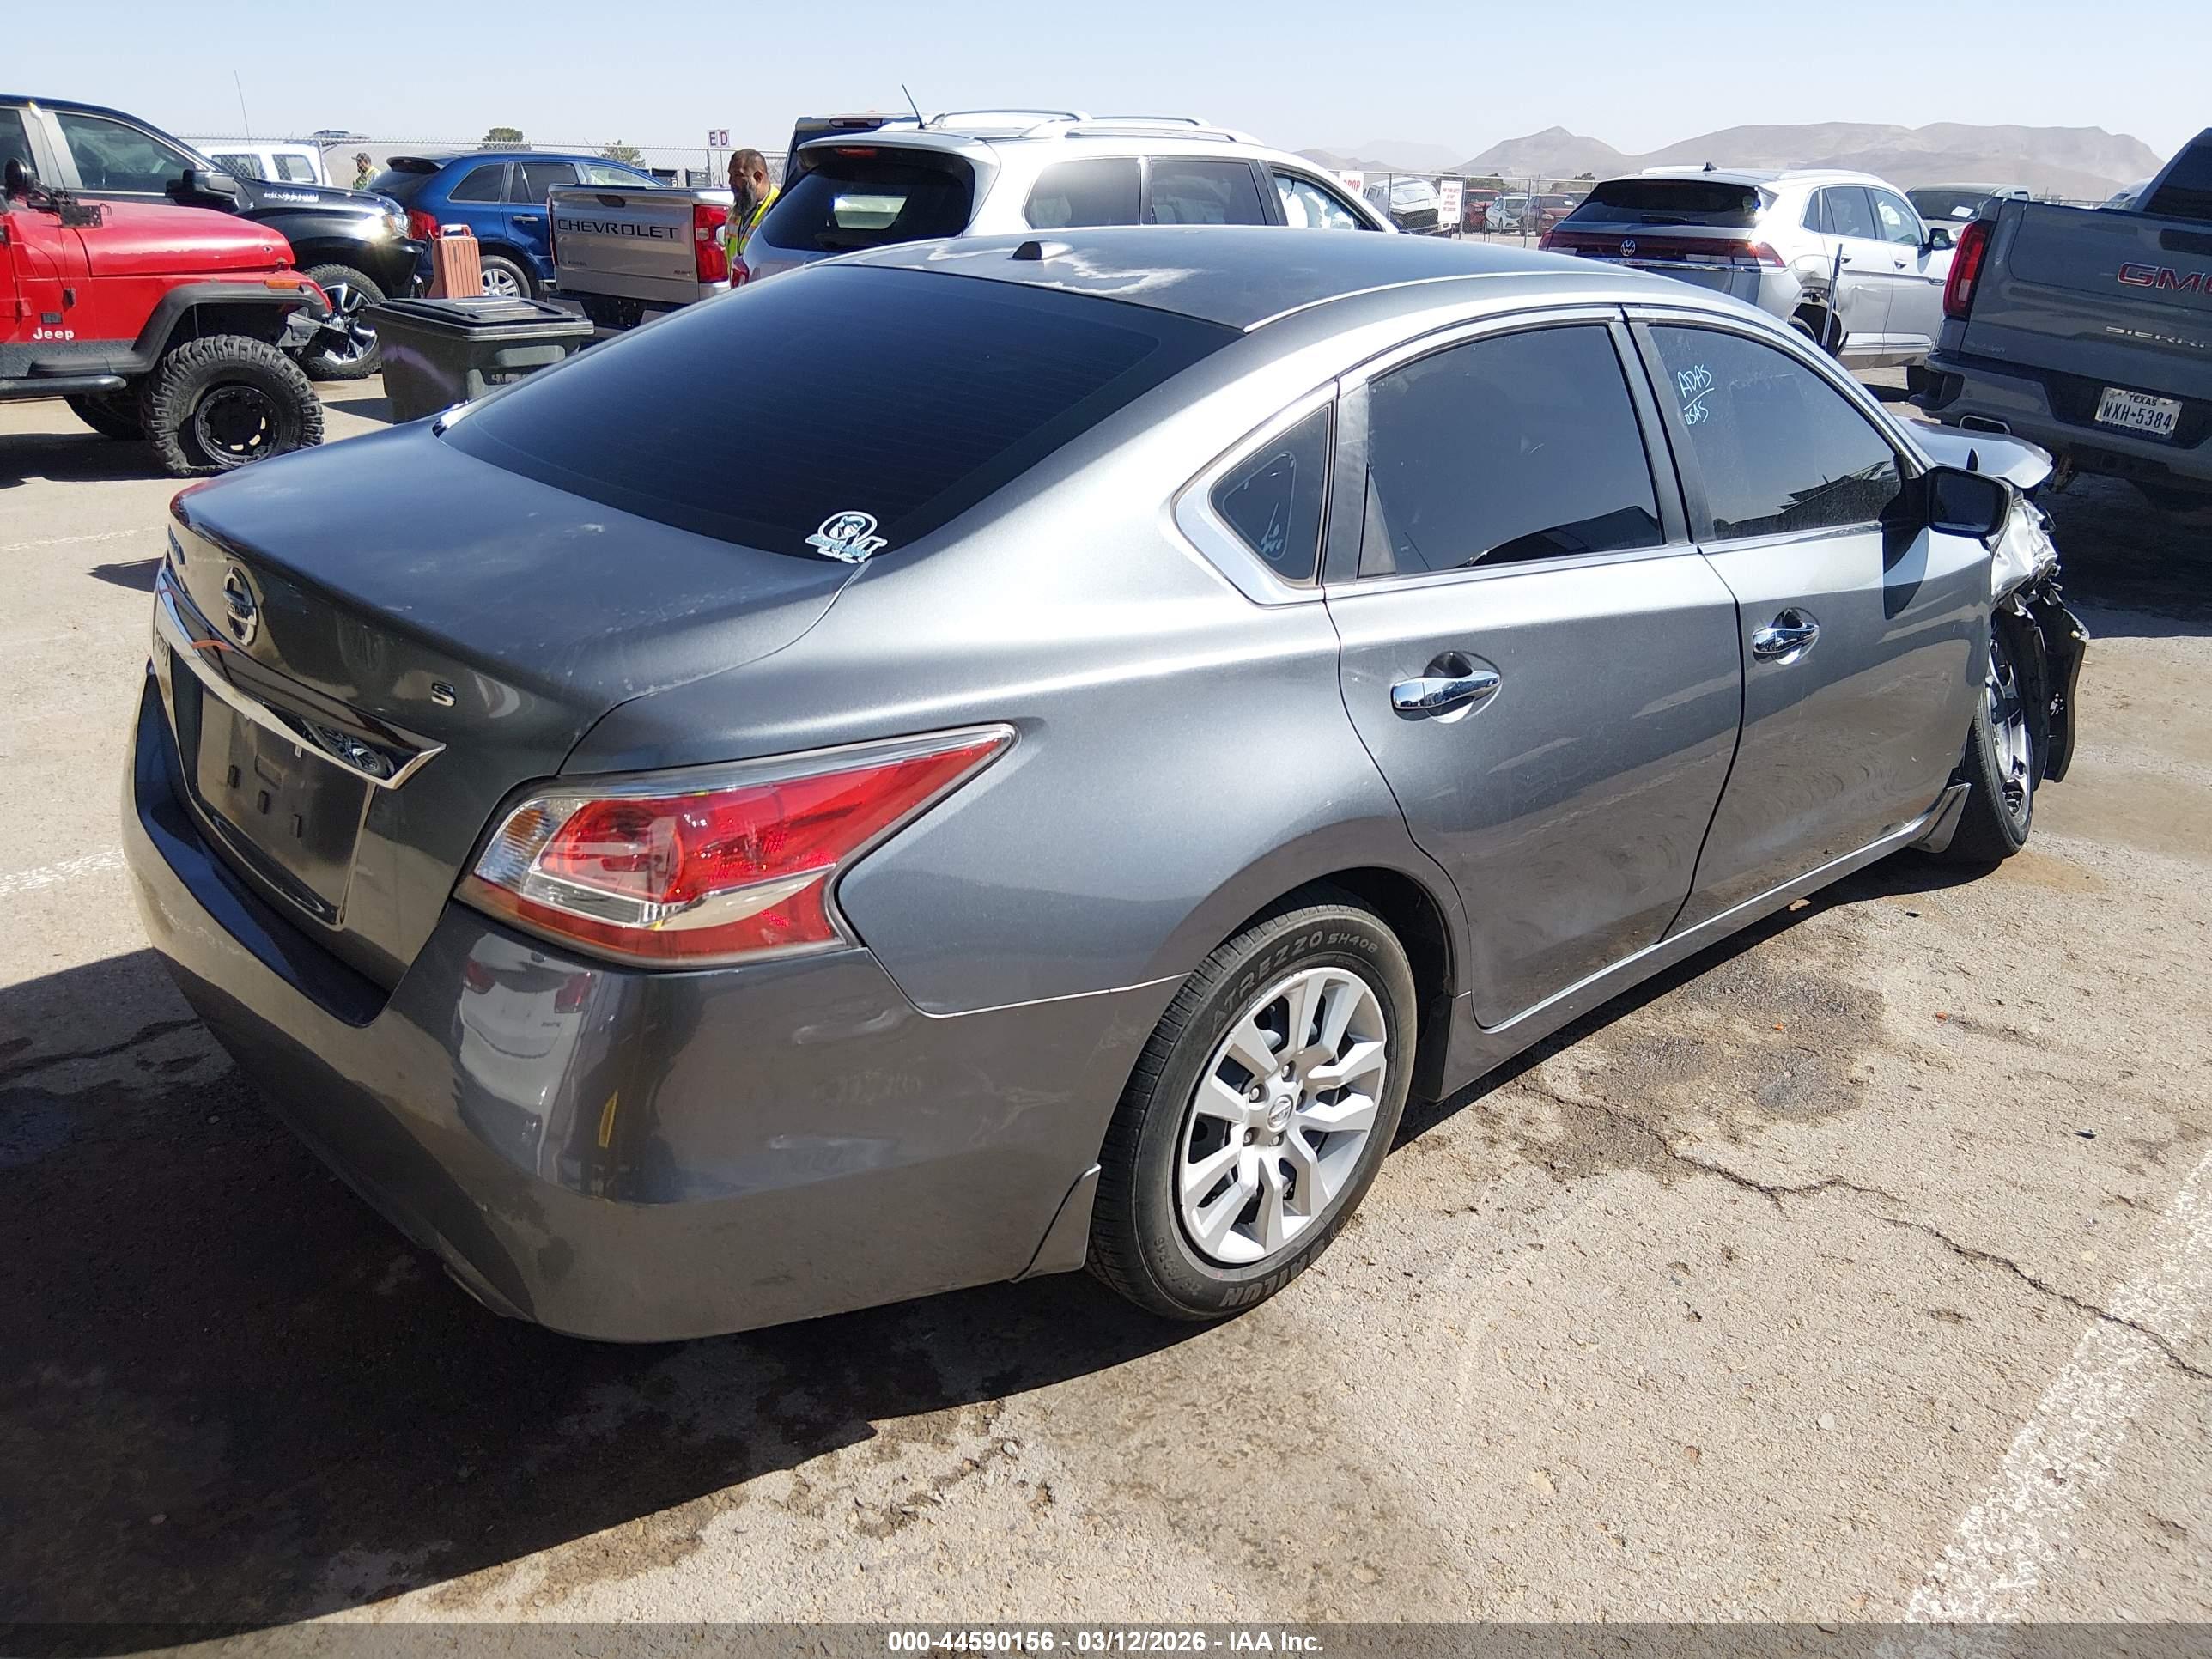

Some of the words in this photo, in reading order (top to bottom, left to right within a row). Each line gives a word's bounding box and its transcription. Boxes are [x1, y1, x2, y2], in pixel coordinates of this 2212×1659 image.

[558, 219, 678, 239] CHEVROLET
[2118, 262, 2212, 294] GM
[33, 327, 75, 341] Jeep
[1677, 364, 1711, 399] ADAS
[2129, 394, 2159, 407] TEXAS
[1212, 930, 1324, 1030] ATREZZO
